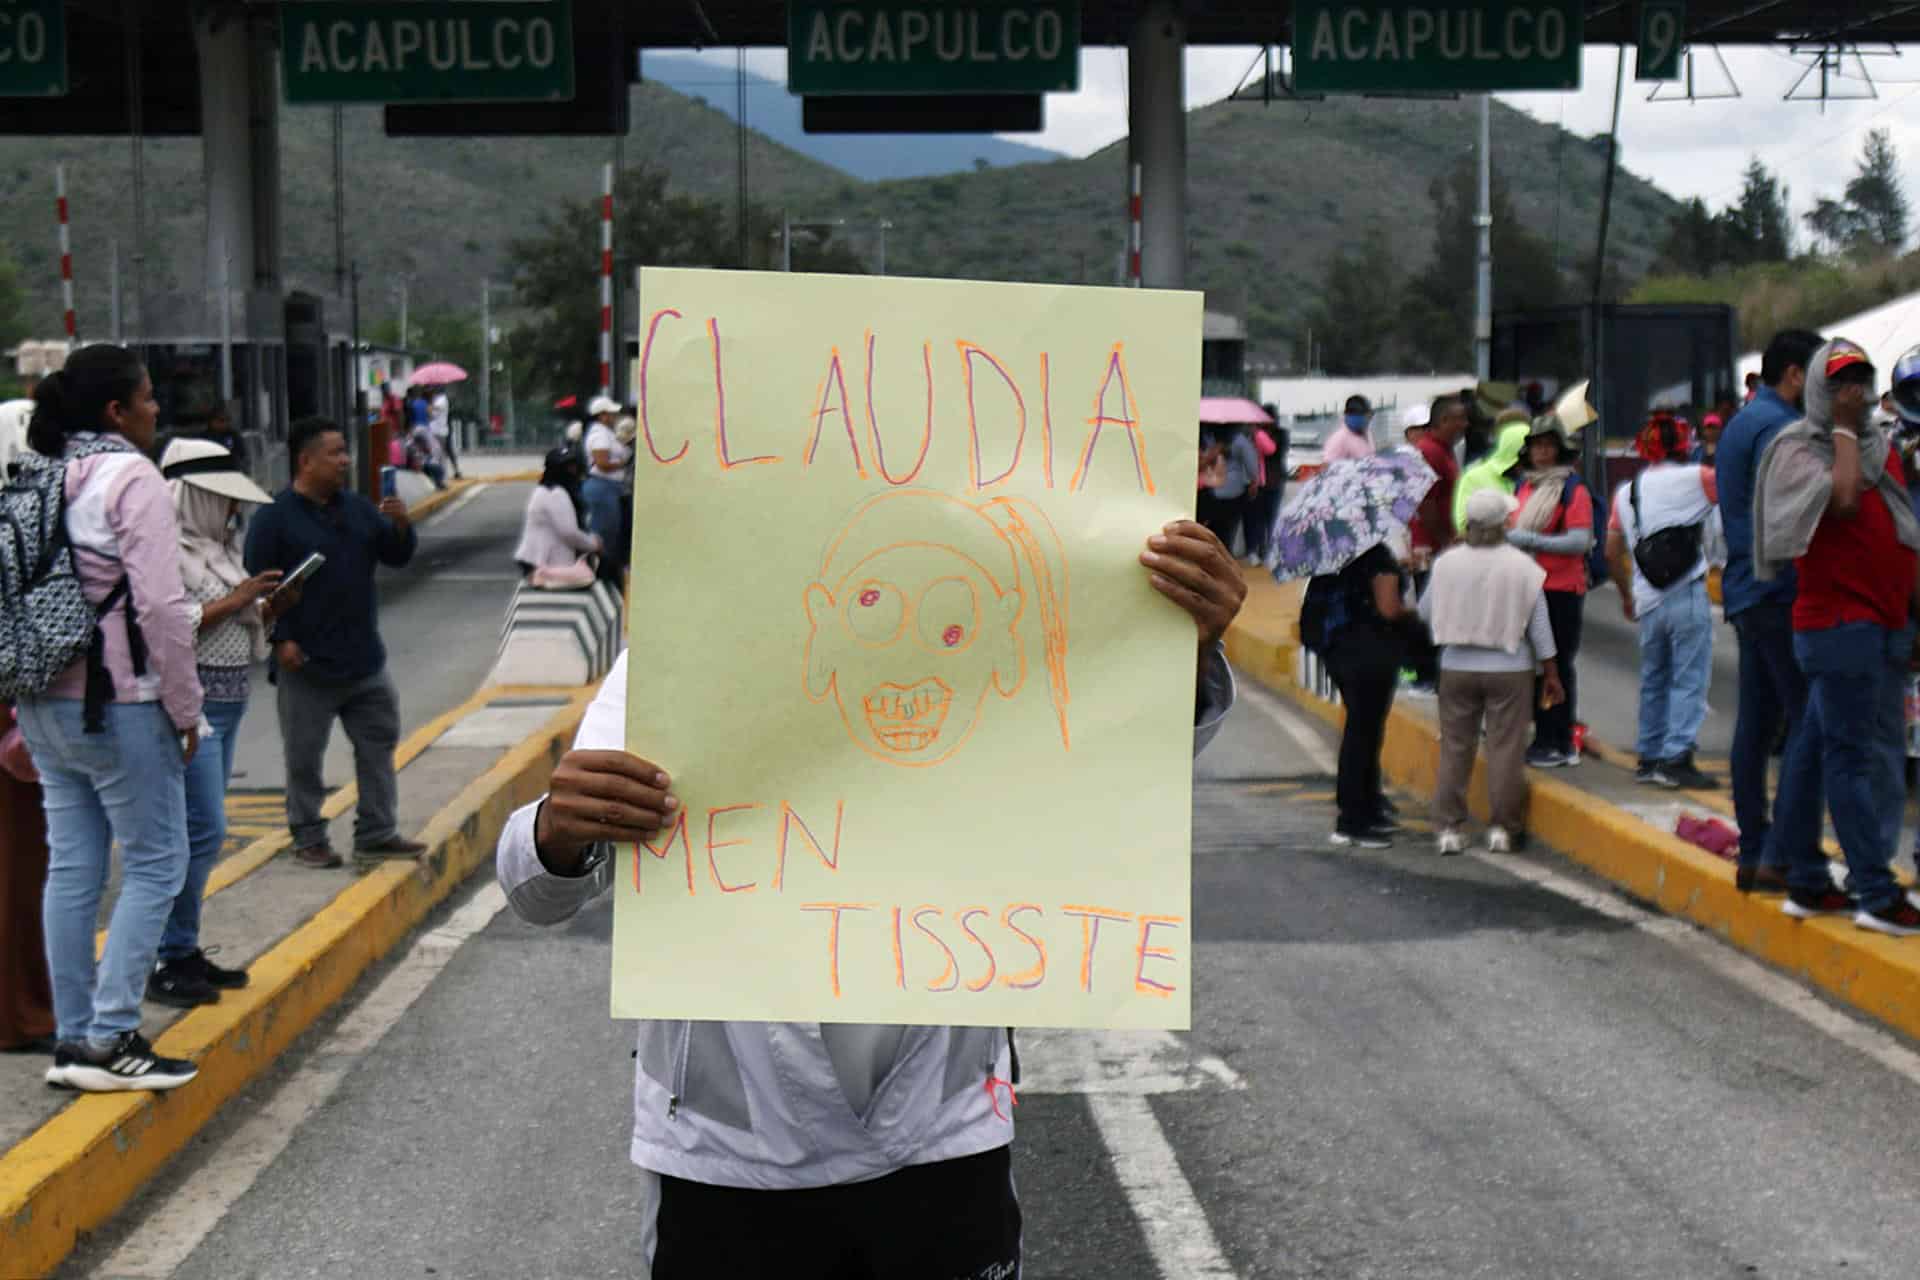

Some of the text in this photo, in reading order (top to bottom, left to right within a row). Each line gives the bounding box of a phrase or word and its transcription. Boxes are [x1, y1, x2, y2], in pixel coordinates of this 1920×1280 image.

[299, 17, 555, 72] ACAPULCO
[806, 9, 1063, 62] ACAPULCO
[1310, 7, 1566, 62] ACAPULCO
[1647, 10, 1676, 70] 9
[640, 309, 1156, 497] CLAUDIA
[632, 799, 845, 897] MEN
[799, 902, 1184, 999] TISSSTE
